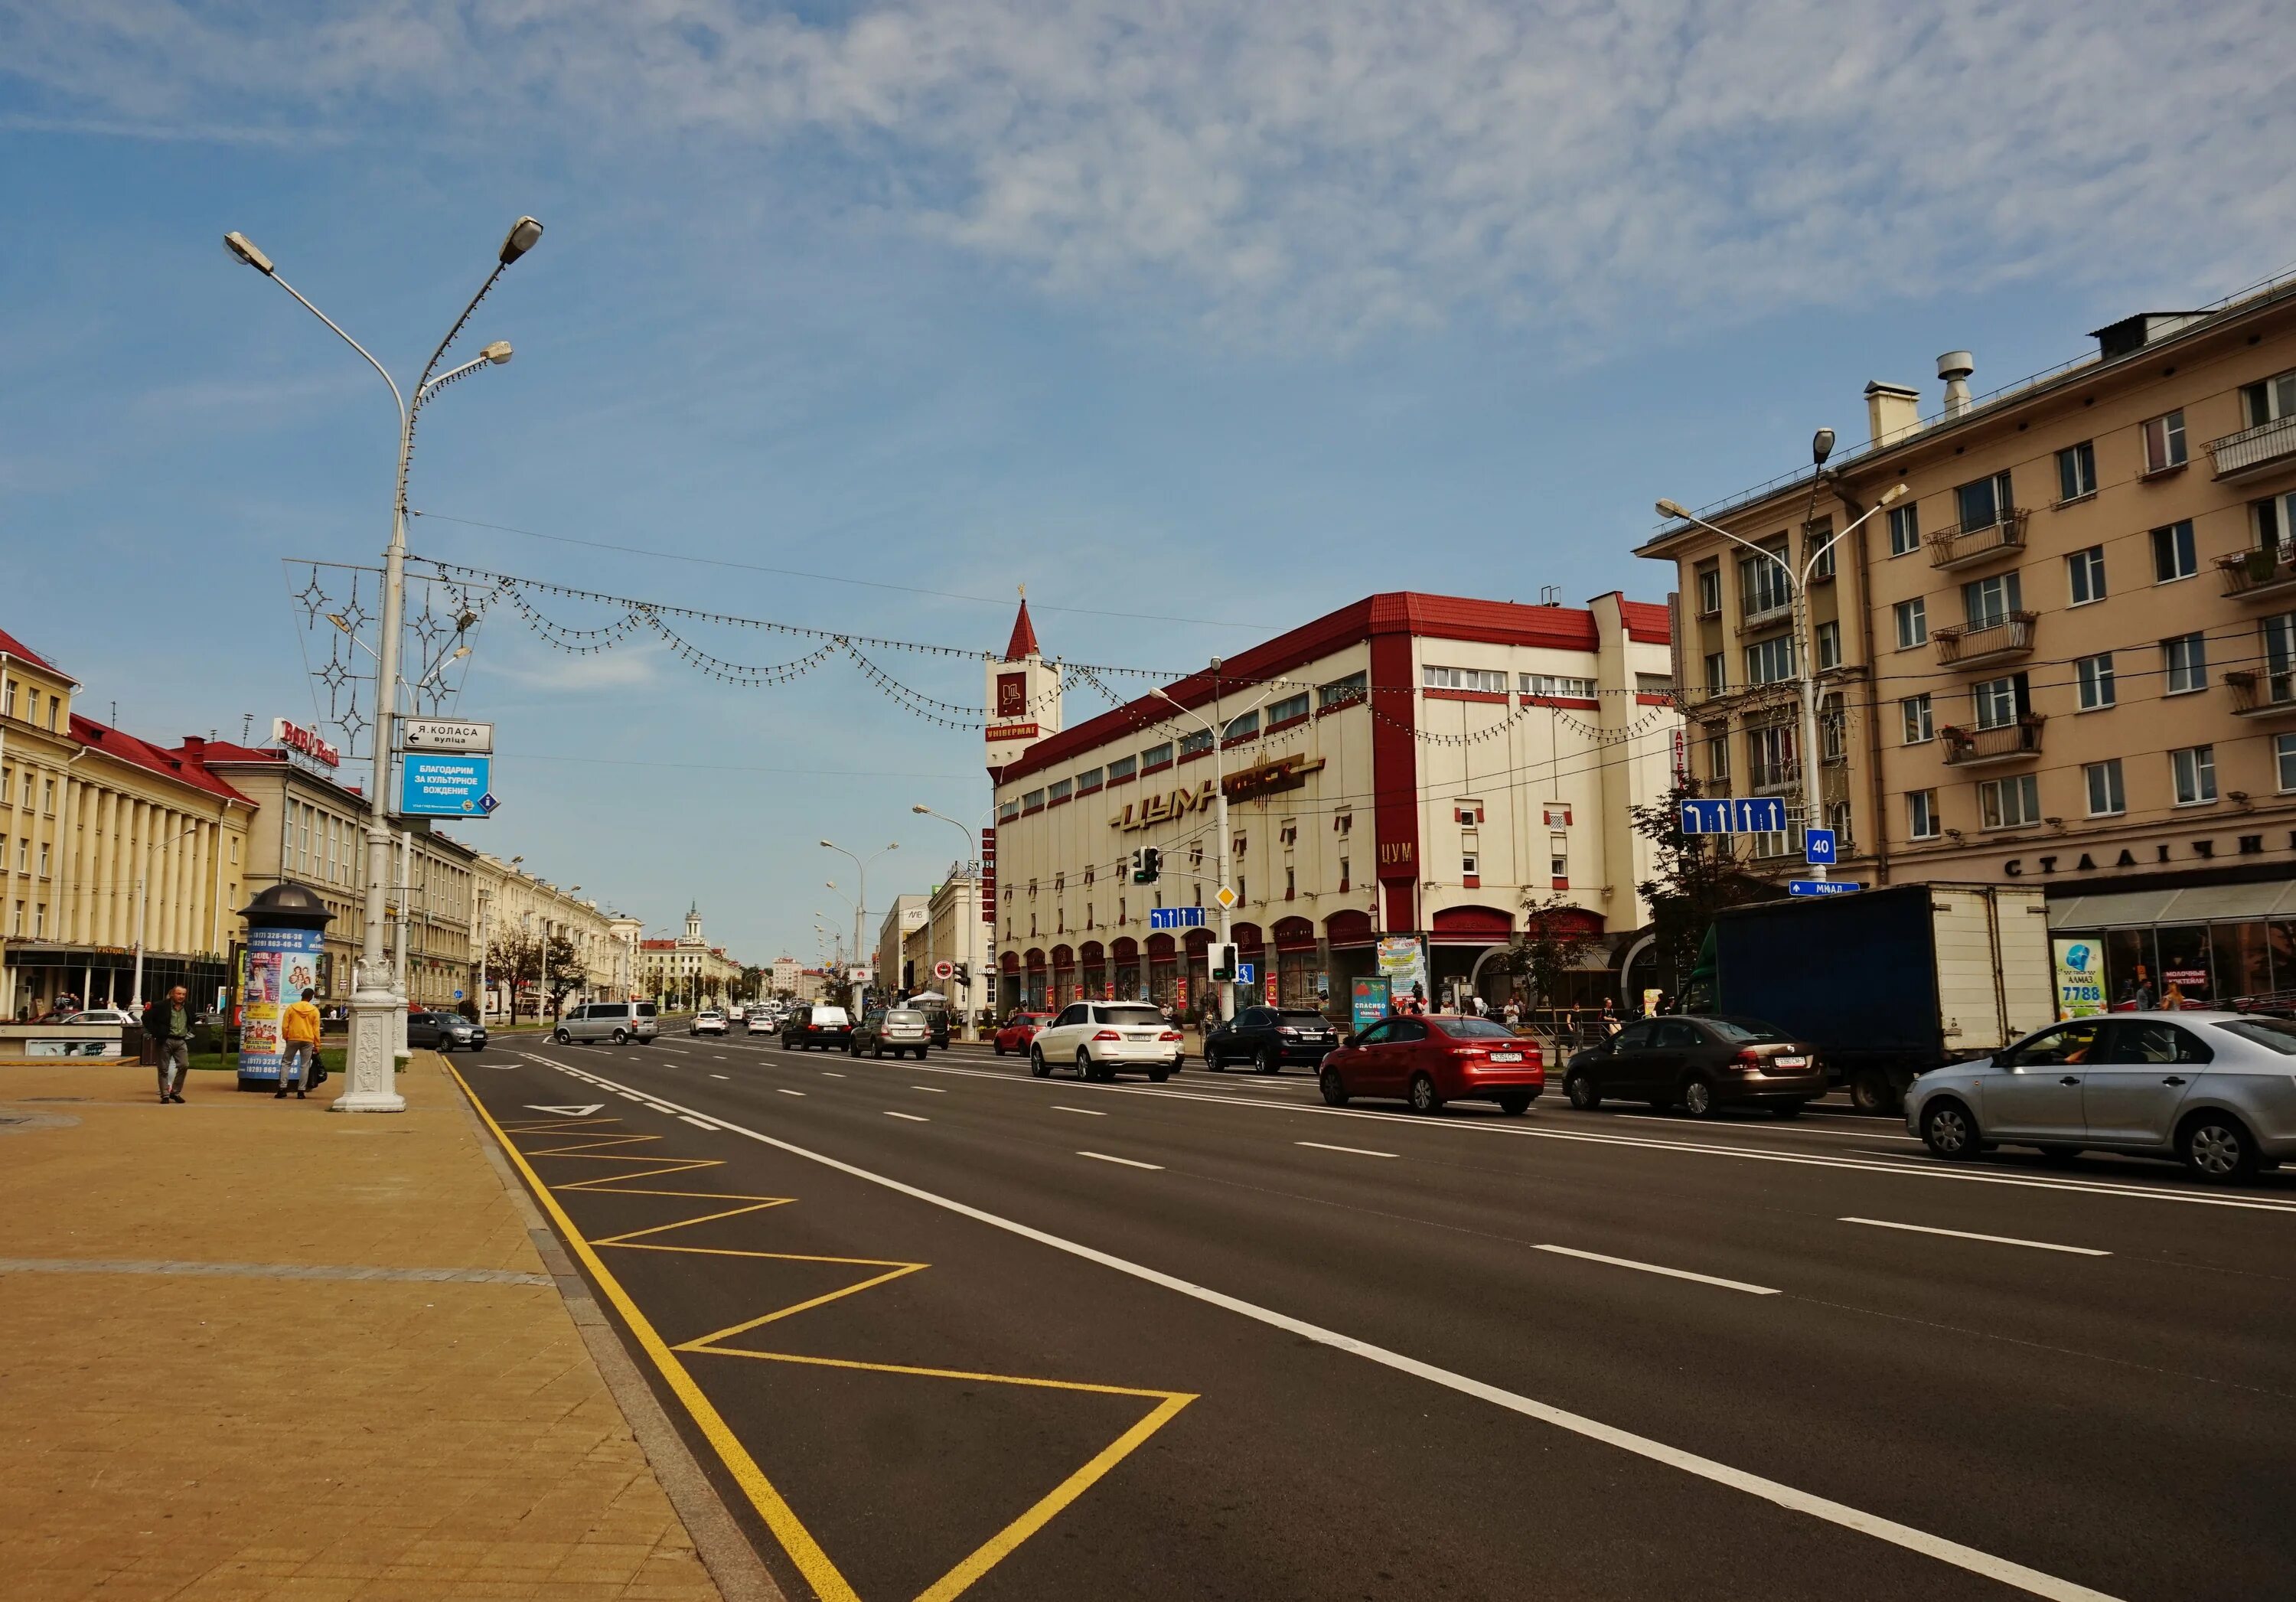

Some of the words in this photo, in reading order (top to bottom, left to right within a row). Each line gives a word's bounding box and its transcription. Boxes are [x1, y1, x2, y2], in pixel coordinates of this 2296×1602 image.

[987, 726, 1035, 737] УНІВЕРМАГ
[419, 765, 474, 775] БЛАГОДАРИМ
[427, 776, 478, 785] КУЛЬТУРНОЕ
[423, 786, 468, 795] ВОЖДЕНИЕ
[1120, 779, 1216, 833] ЦУМ
[1812, 840, 1829, 853] 40
[1381, 843, 1412, 864] ЦУМ
[2063, 987, 2100, 1000] 7788
